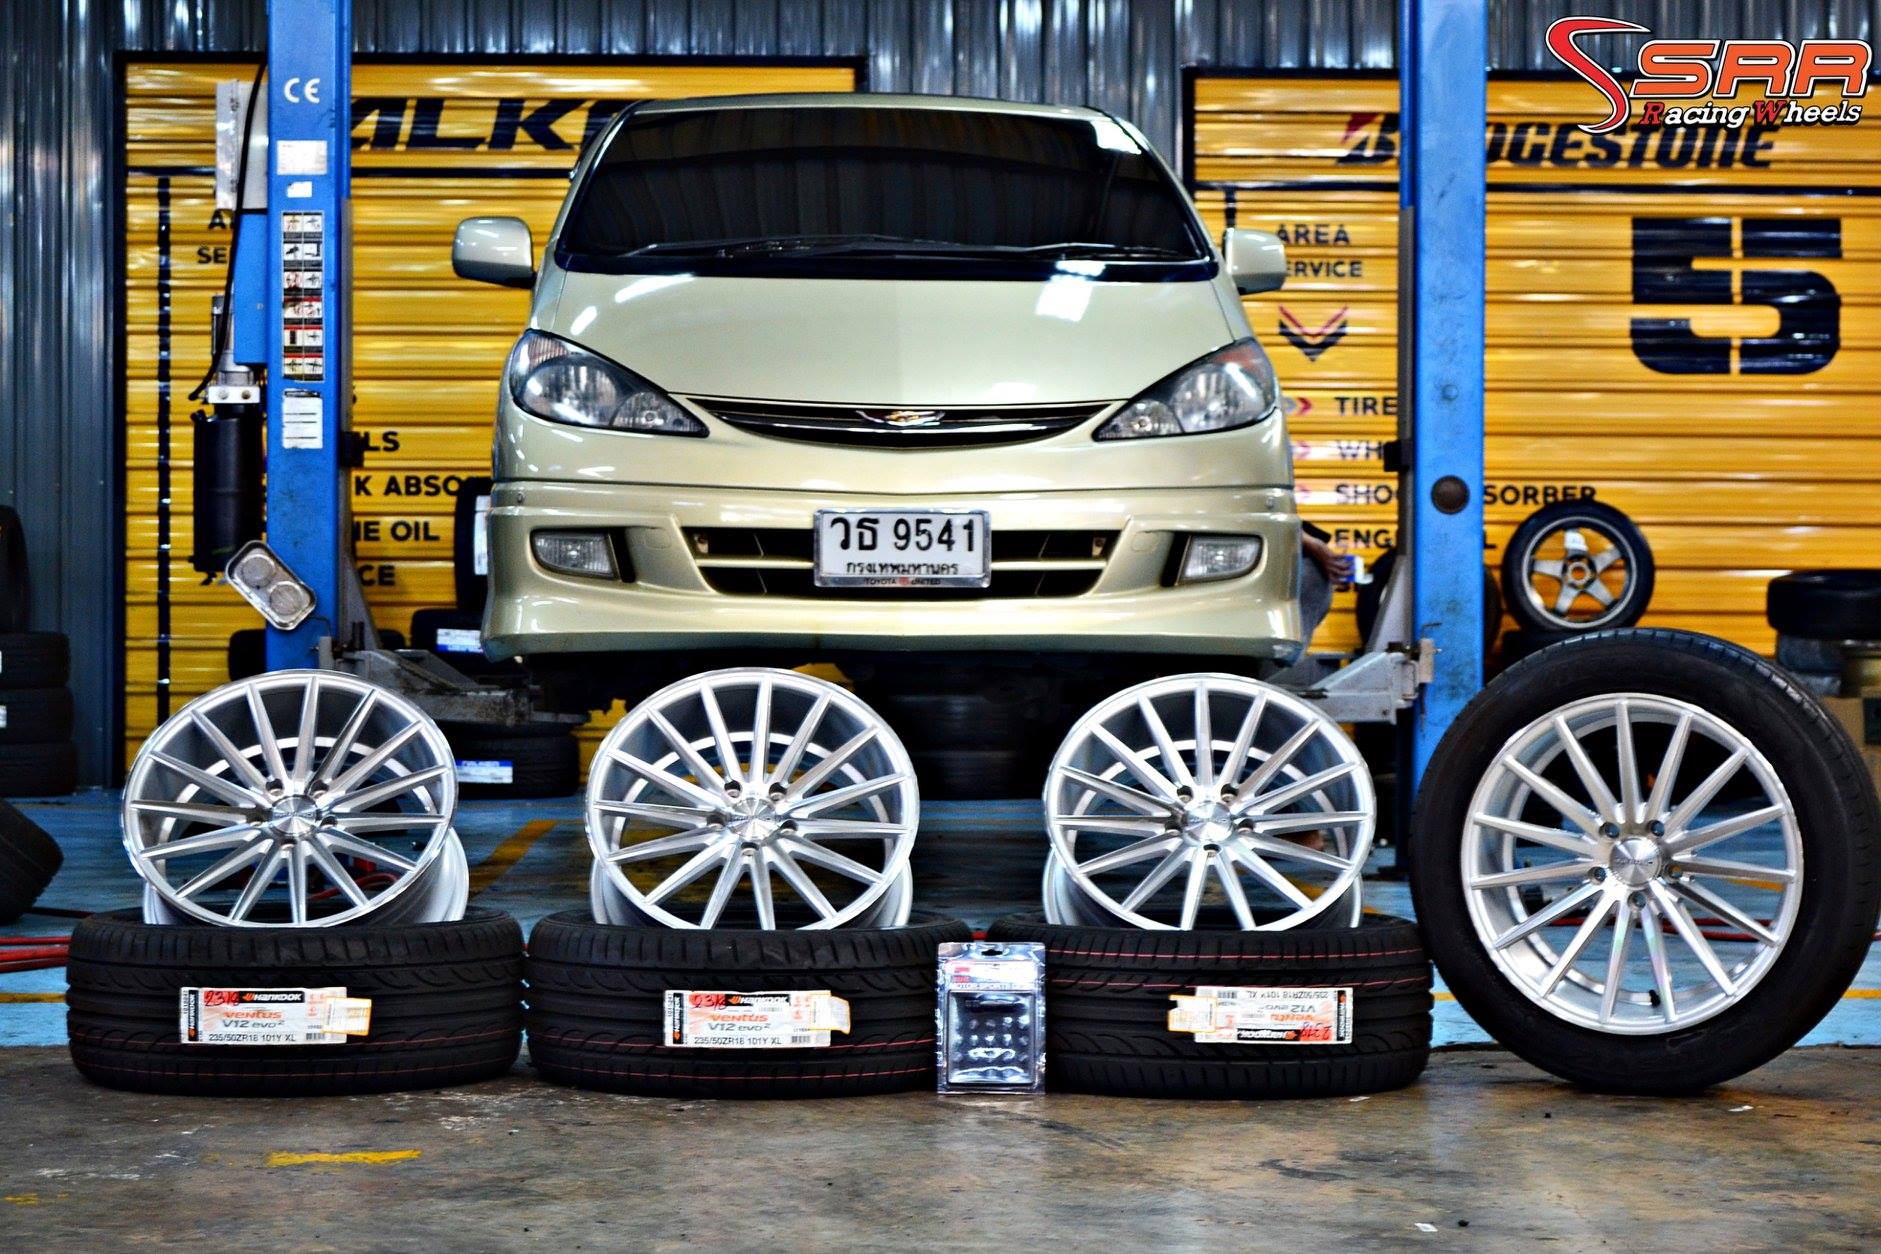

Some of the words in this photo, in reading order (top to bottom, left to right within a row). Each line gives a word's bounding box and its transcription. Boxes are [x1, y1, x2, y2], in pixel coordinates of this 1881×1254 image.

[284, 78, 320, 103] CE
[1277, 224, 1350, 245] AREA
[1630, 218, 1842, 375] 5
[1336, 484, 1398, 504] SHO
[391, 520, 440, 541] OIL
[894, 518, 974, 552] 9541
